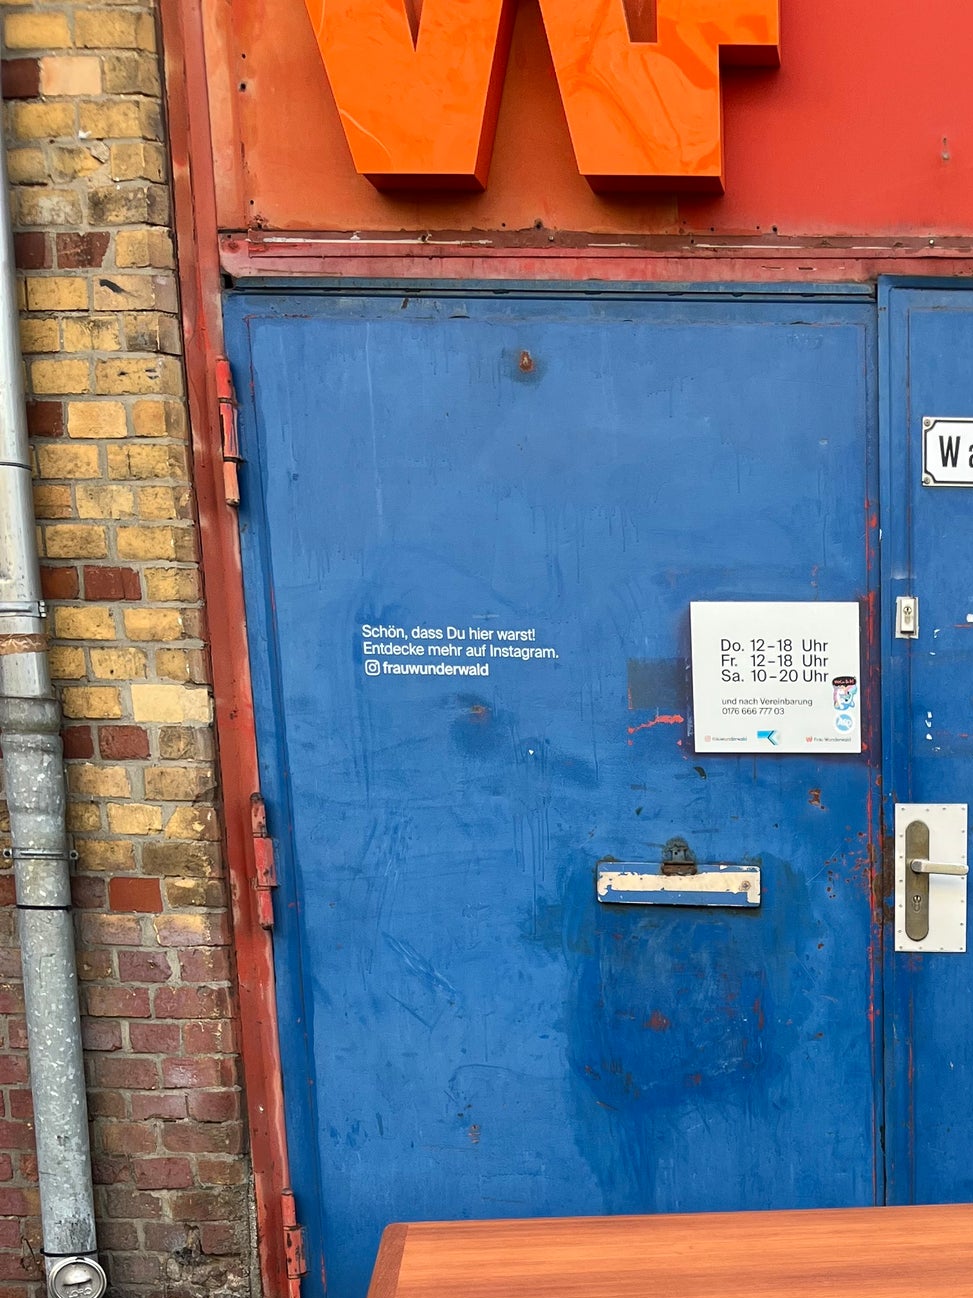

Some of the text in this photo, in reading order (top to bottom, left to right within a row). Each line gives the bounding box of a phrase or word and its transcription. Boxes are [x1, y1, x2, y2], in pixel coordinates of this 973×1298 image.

[361, 624, 536, 642] Schön, dass Du hier warst!
[363, 641, 559, 660] Entdecke mehr auf Instagram.
[720, 638, 745, 652] Do.
[802, 638, 829, 652] Uhr
[721, 654, 738, 667] Fr.
[802, 654, 829, 667] Uhr
[382, 660, 490, 676] frauwunderwald
[721, 669, 745, 682] Sa.
[802, 669, 829, 682] Uhr
[721, 697, 813, 707] und nach Vereinbarung
[721, 707, 785, 715] 0176 666 777 03
